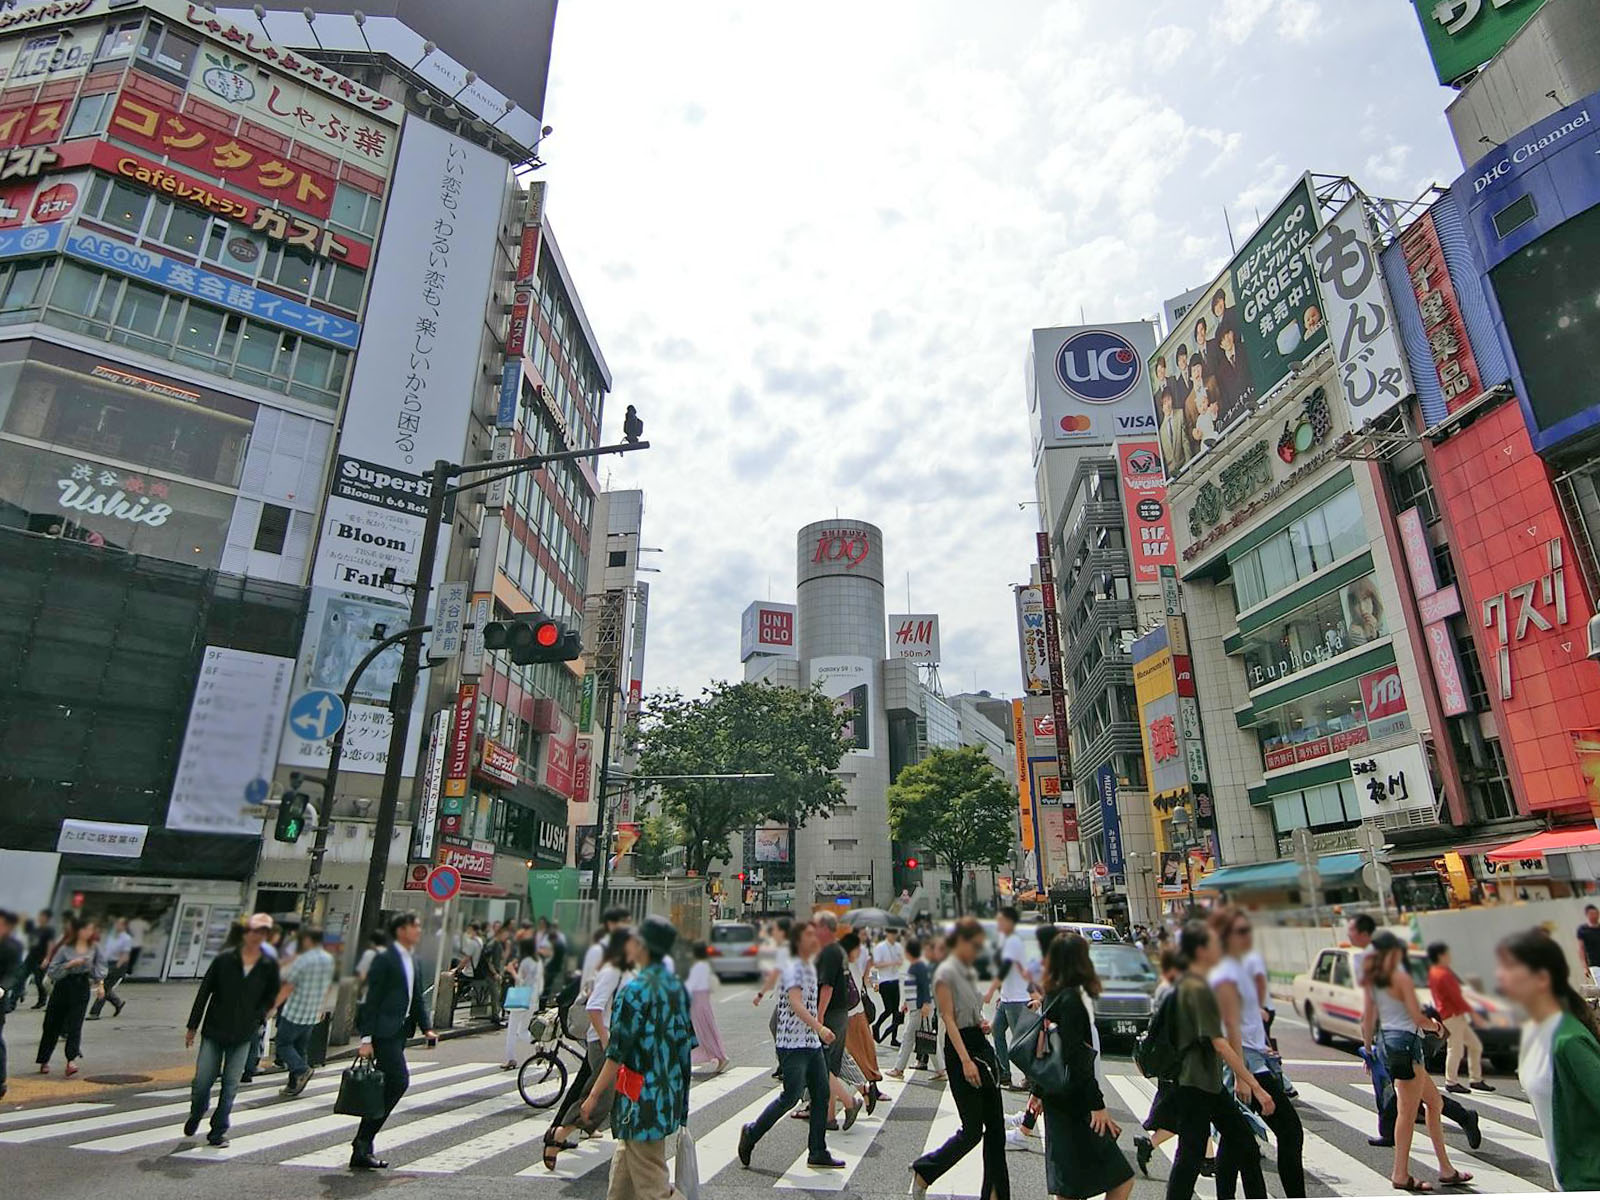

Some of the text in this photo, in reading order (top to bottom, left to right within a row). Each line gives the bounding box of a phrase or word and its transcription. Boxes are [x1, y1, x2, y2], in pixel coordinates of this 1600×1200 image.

[267, 85, 387, 158] しゃぶ葉
[114, 99, 328, 205] コンタクト
[1474, 110, 1591, 193] DHC Channel
[37, 200, 72, 214] ガスト
[24, 233, 46, 247] 6F
[252, 206, 348, 258] ガスト
[1237, 204, 1305, 288] 関ジャニ∞
[1241, 228, 1311, 300] ベストアルバム
[1244, 245, 1311, 323] GR8EST
[76, 236, 354, 338] AEON 英会話イーオン
[395, 142, 467, 465] いい恋も、わるい恋も、楽しいから困る。
[1315, 224, 1401, 408] もんじゃ
[1116, 415, 1156, 429] VISA
[810, 537, 869, 569] 109
[822, 530, 867, 538] SHIBUYA
[443, 588, 463, 651] 渋谷駅前
[763, 614, 788, 626] UNI
[763, 628, 789, 642] QLO
[895, 620, 933, 645] H&M
[1482, 536, 1568, 701] クスリ
[900, 650, 923, 658] 150m
[1253, 635, 1344, 684] Euphoria
[1368, 674, 1402, 714] JTB
[453, 707, 472, 773] サンドラッグ
[576, 764, 586, 789] アコム
[1103, 774, 1113, 806] MIZUHO
[539, 821, 566, 854] LUSH
[453, 851, 484, 872] サンドラッグ
